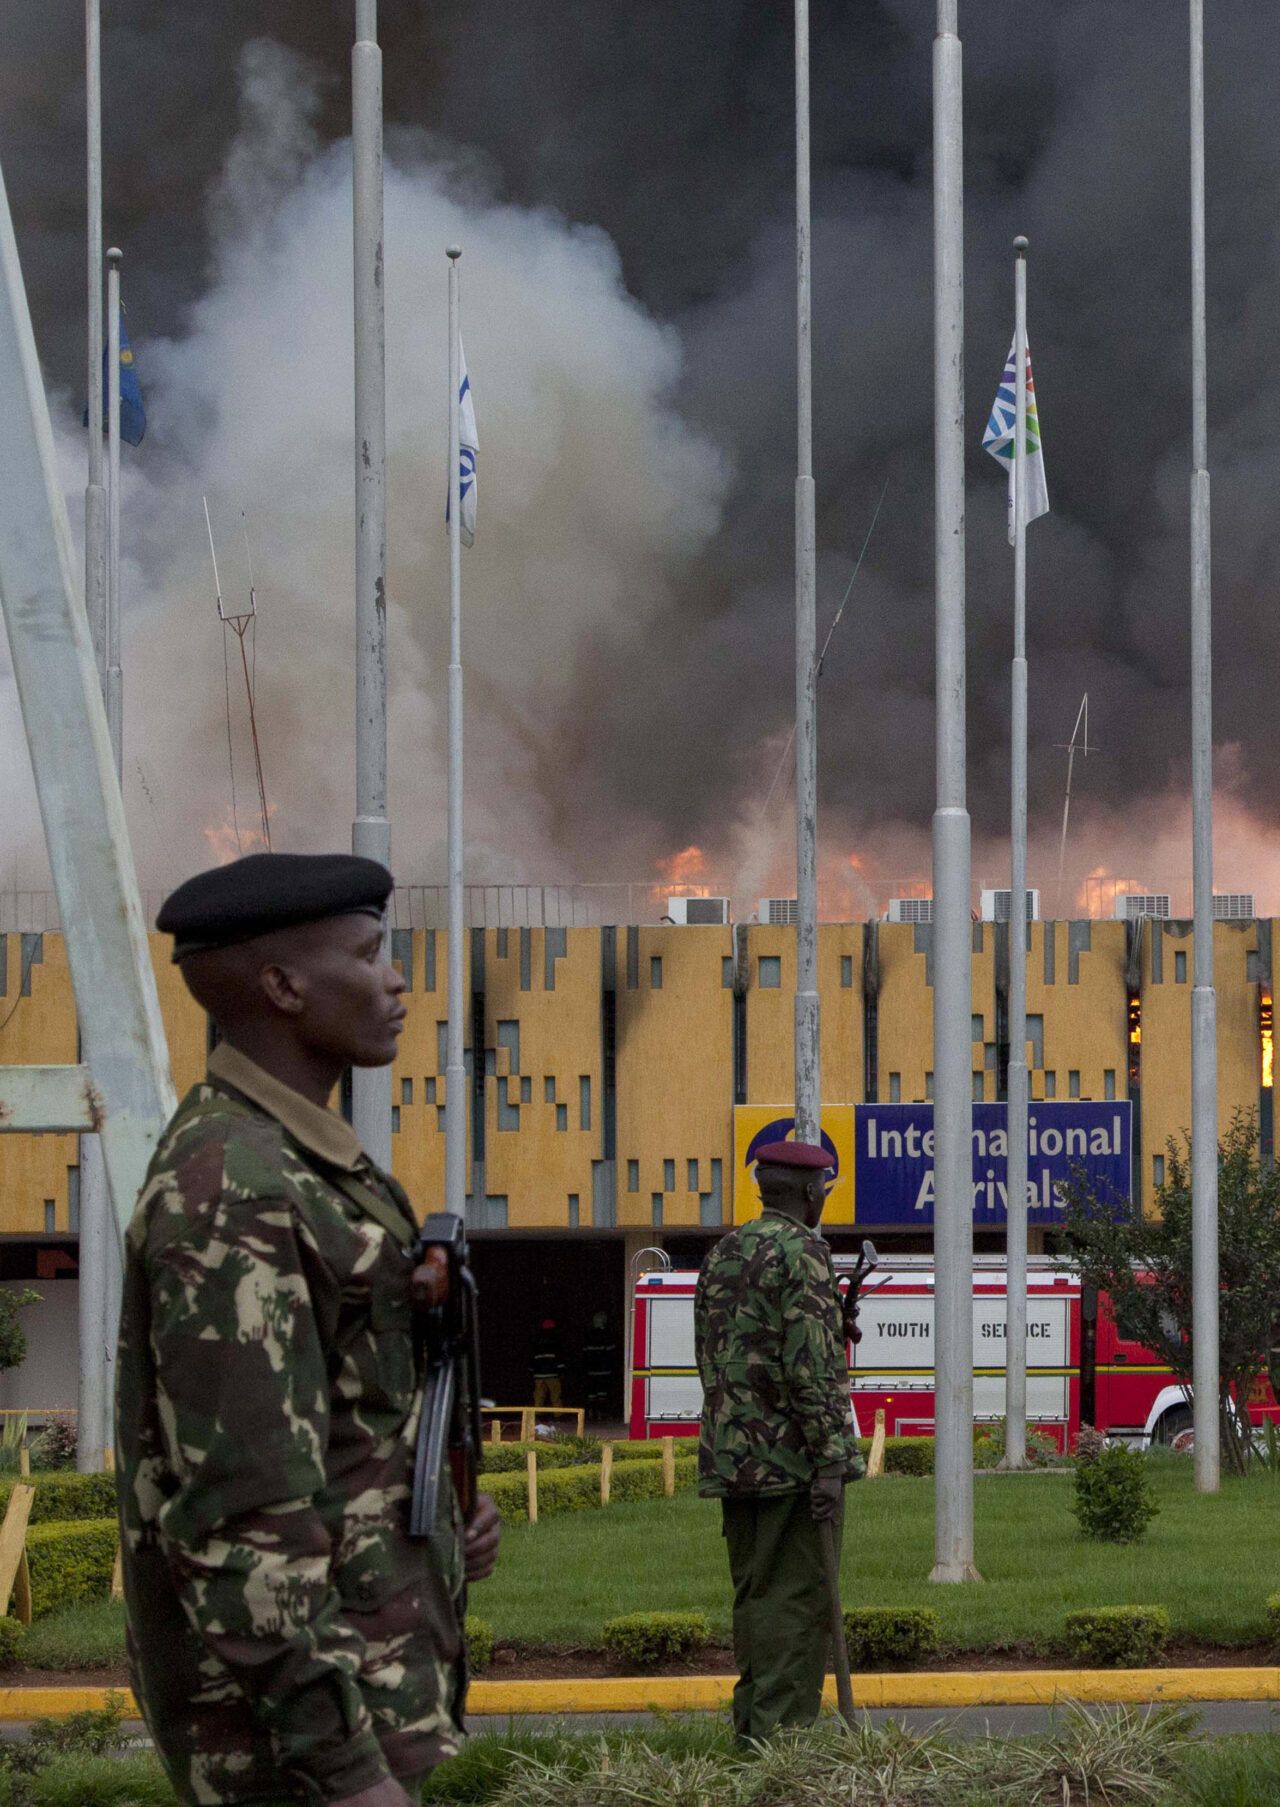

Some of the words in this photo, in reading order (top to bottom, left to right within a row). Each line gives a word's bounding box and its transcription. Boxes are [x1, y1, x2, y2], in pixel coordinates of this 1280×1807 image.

[867, 1115, 1121, 1158] Intenaional
[914, 1168, 1070, 1210] Arivals
[877, 1323, 930, 1338] YOUTH
[981, 1323, 1051, 1338] SEICE
